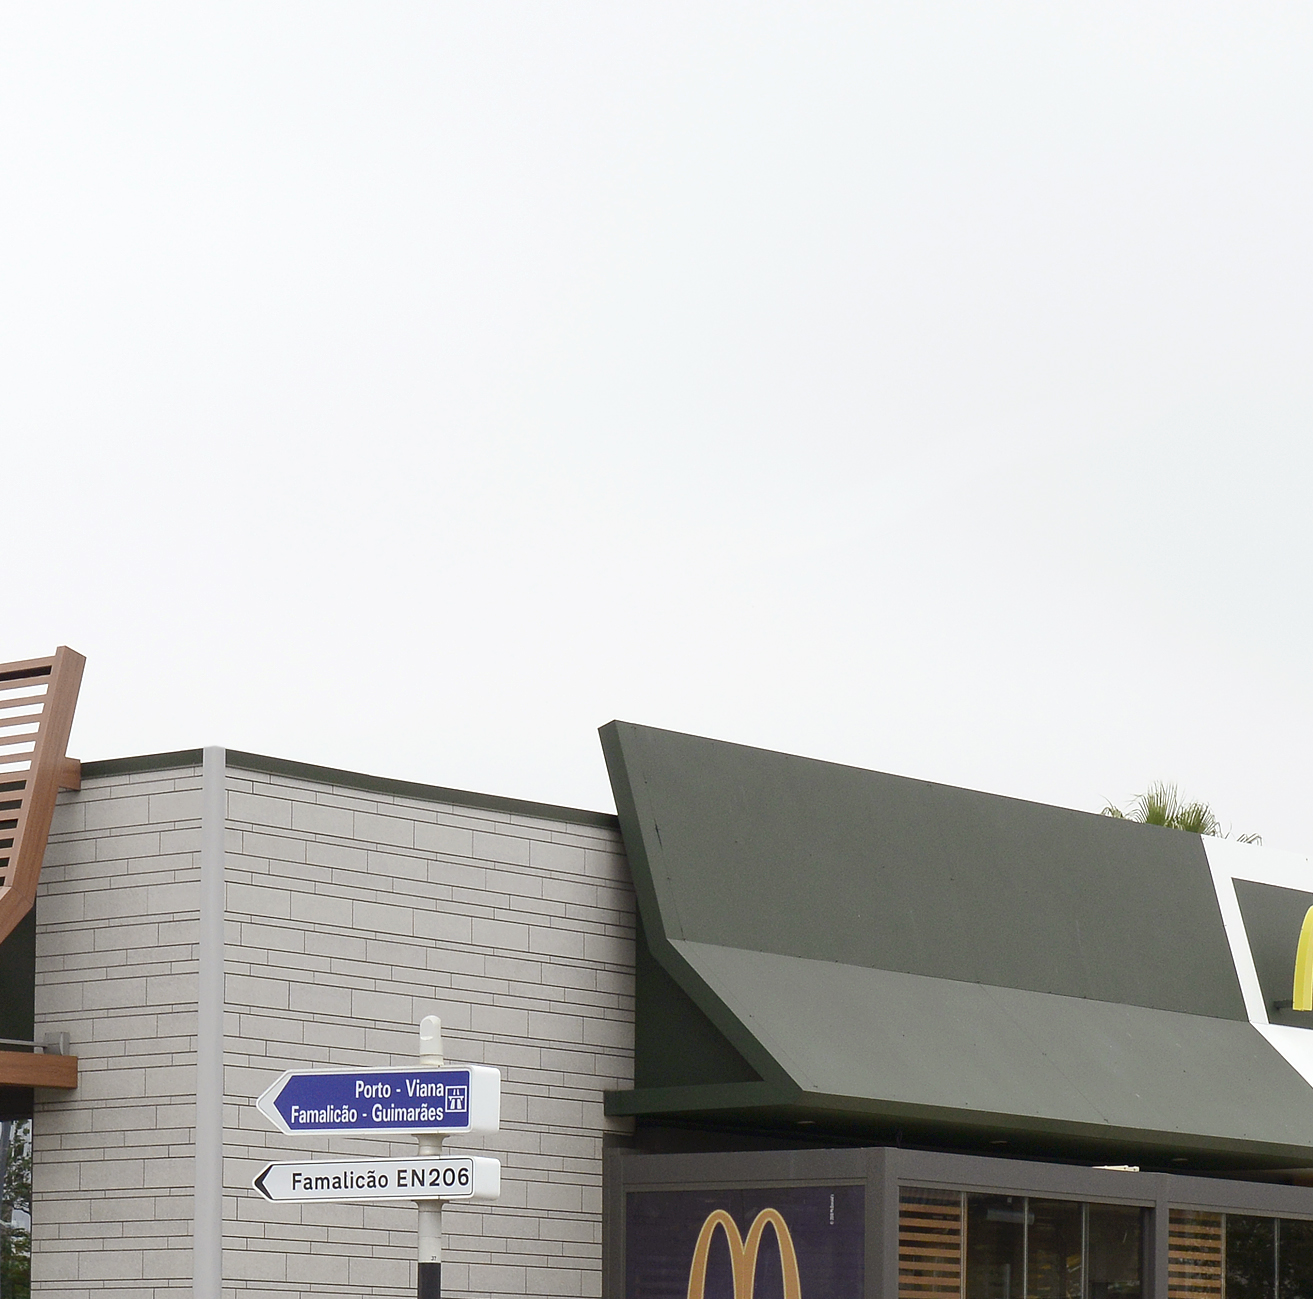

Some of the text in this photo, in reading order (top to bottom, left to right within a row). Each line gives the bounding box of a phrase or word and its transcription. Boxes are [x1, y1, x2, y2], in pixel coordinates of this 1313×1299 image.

[355, 1080, 391, 1099] Porto
[406, 1078, 444, 1098] Viana
[291, 1105, 358, 1124] Famalicão
[371, 1102, 444, 1123] Guimarães
[292, 1167, 470, 1191] Famalicão EN206
